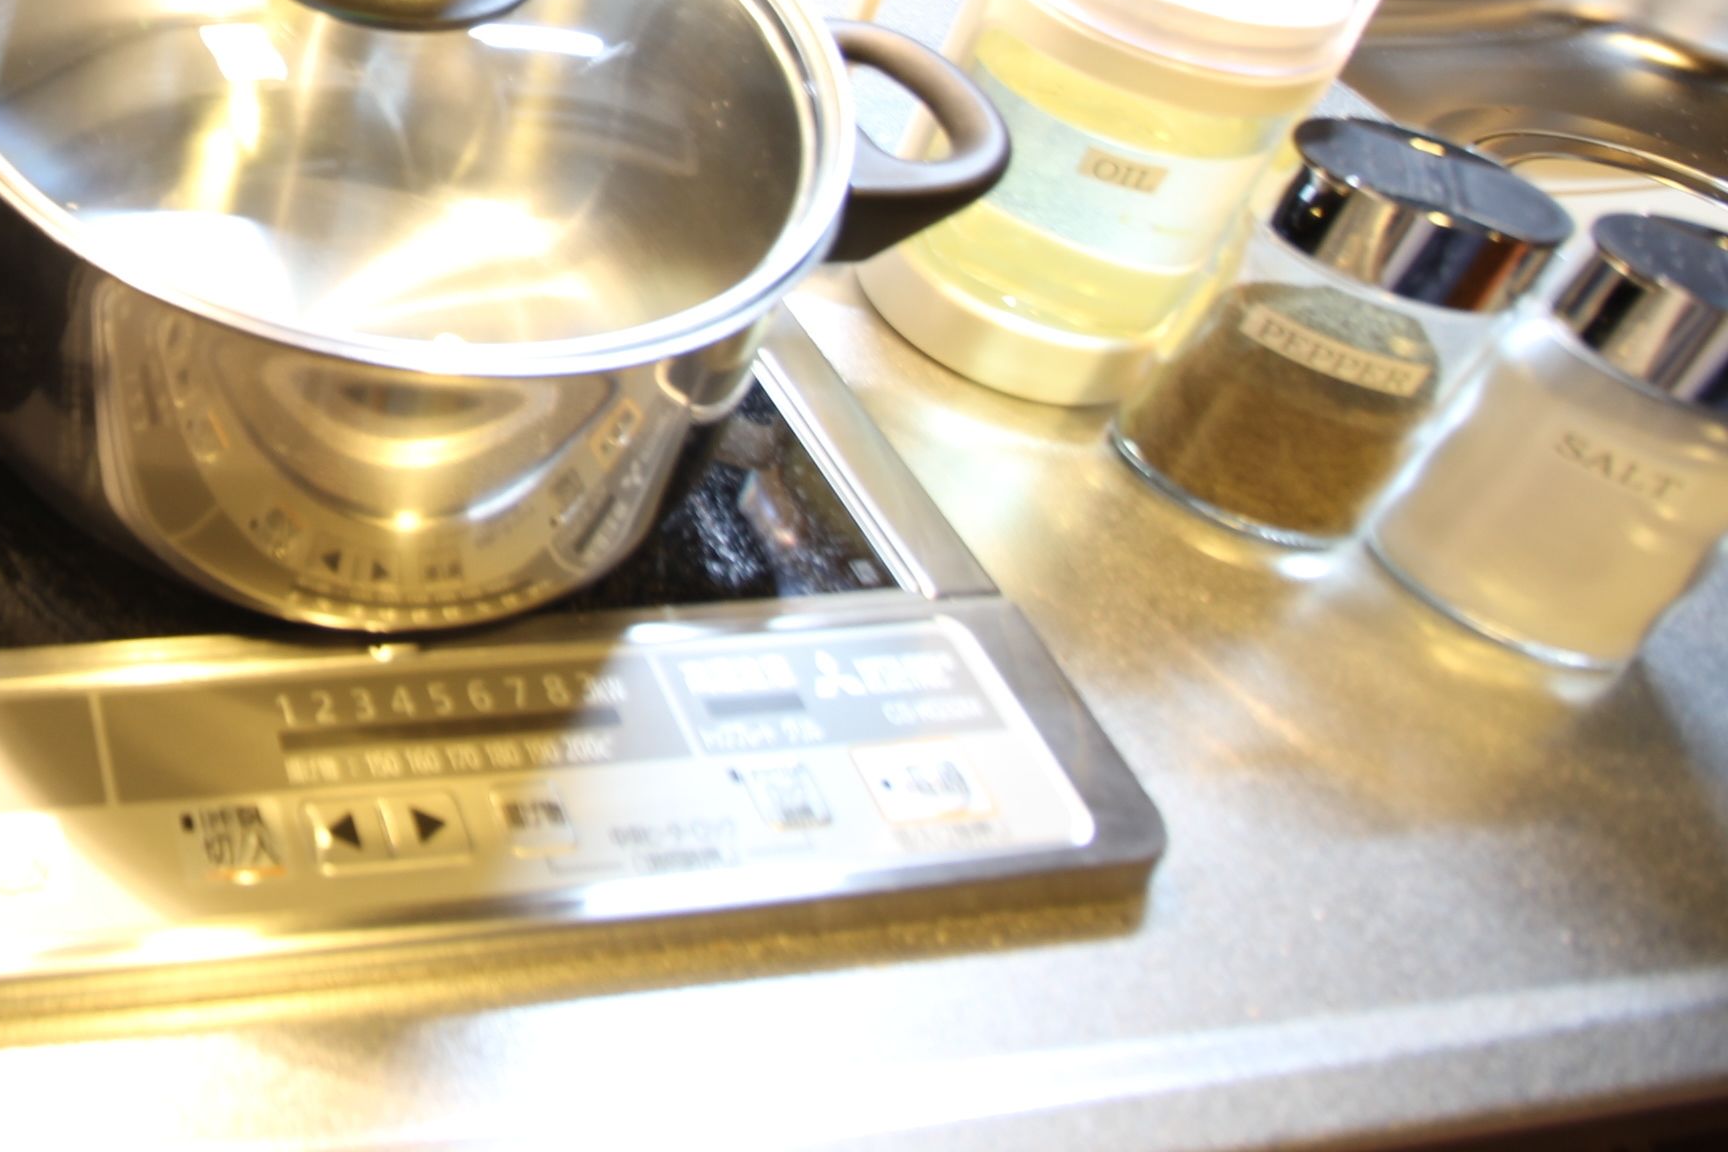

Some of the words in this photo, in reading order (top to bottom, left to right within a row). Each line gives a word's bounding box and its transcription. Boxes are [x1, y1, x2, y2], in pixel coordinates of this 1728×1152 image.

[1091, 158, 1157, 192] OIL
[1258, 318, 1413, 391] PEPPER
[1553, 430, 1687, 498] SALT
[278, 693, 297, 729] 1
[313, 690, 337, 725] 2
[350, 687, 377, 722] 3
[390, 684, 415, 718] 4
[428, 681, 455, 716] 5
[466, 678, 494, 714] 6
[503, 676, 526, 709] 7
[541, 673, 571, 708] 8
